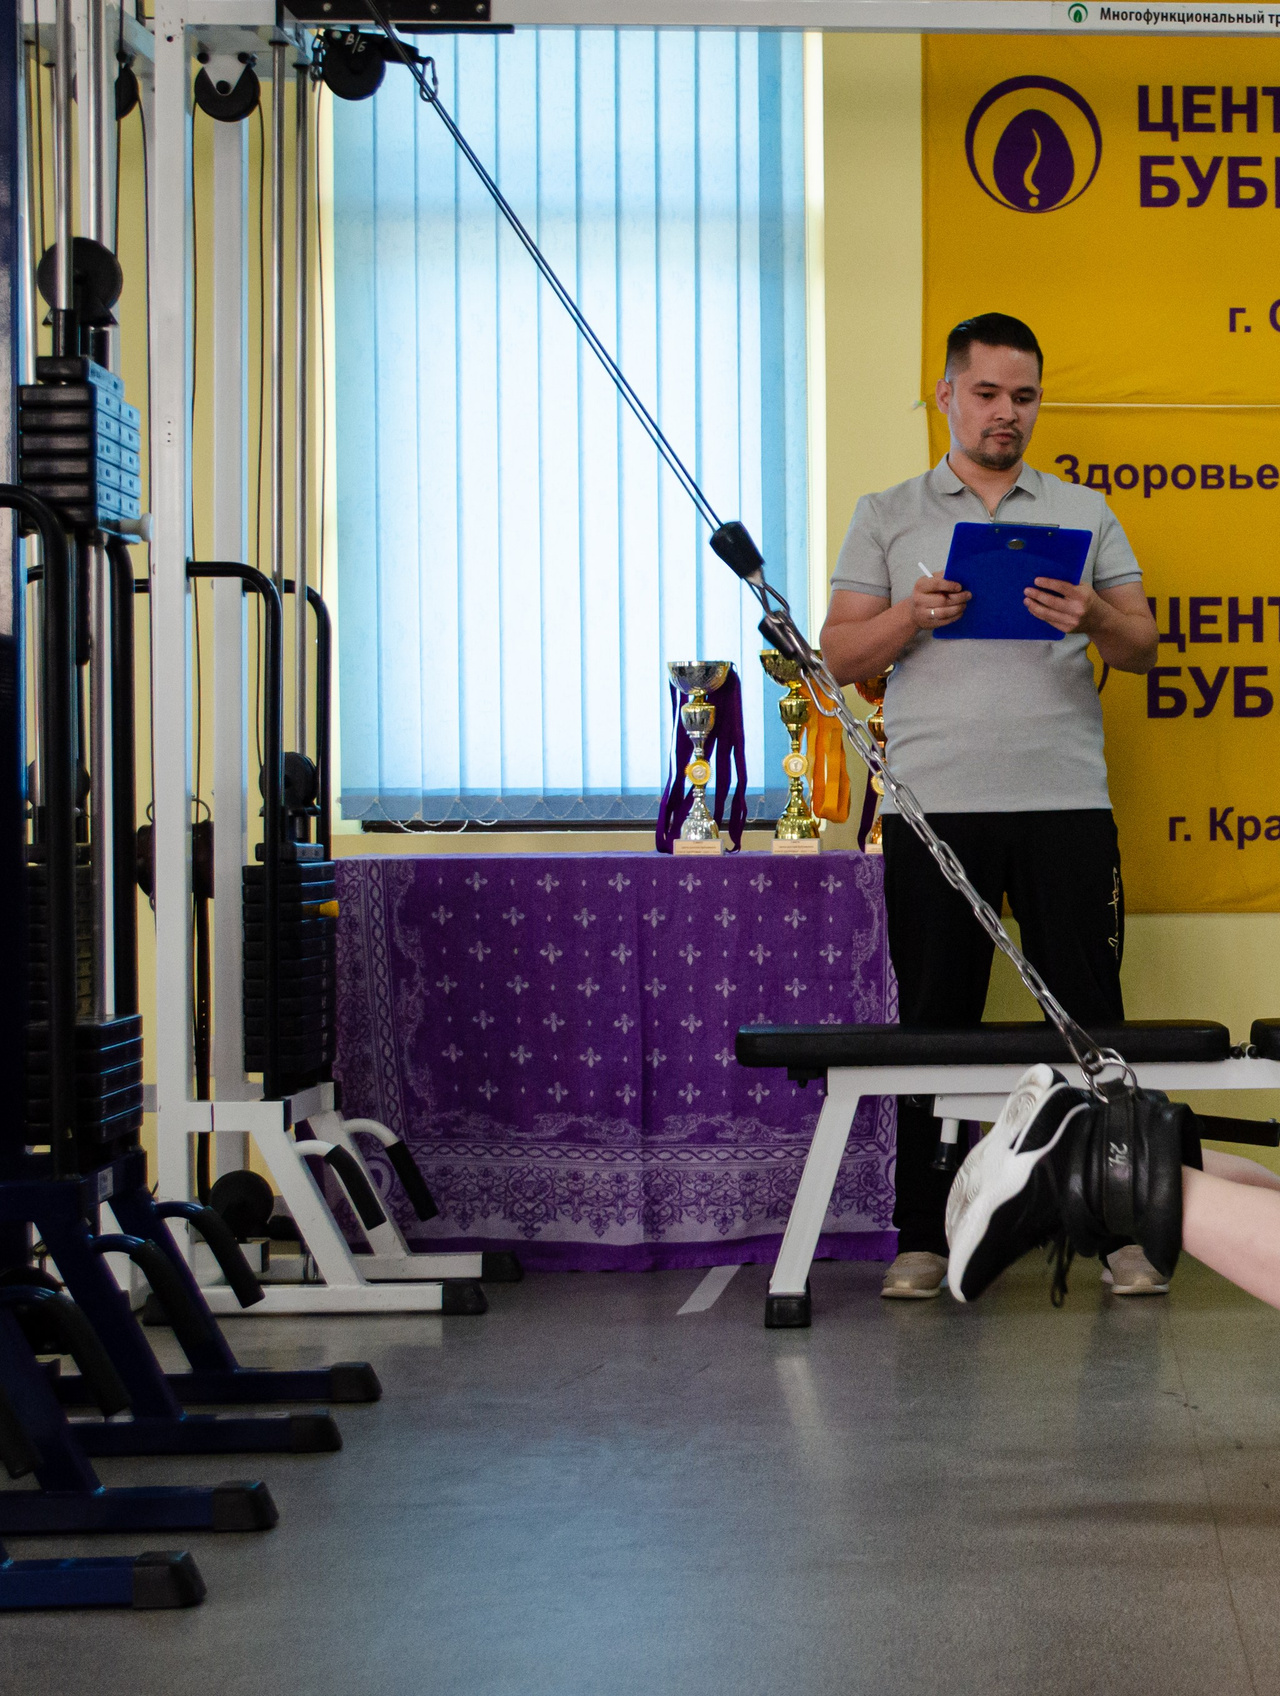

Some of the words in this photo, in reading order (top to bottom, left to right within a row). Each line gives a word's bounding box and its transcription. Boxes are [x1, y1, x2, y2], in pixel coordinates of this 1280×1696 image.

[1099, 6, 1264, 26] Многофункциональный
[1229, 307, 1251, 333] г.
[1055, 454, 1279, 498] Здоровье
[1168, 816, 1191, 842] г.
